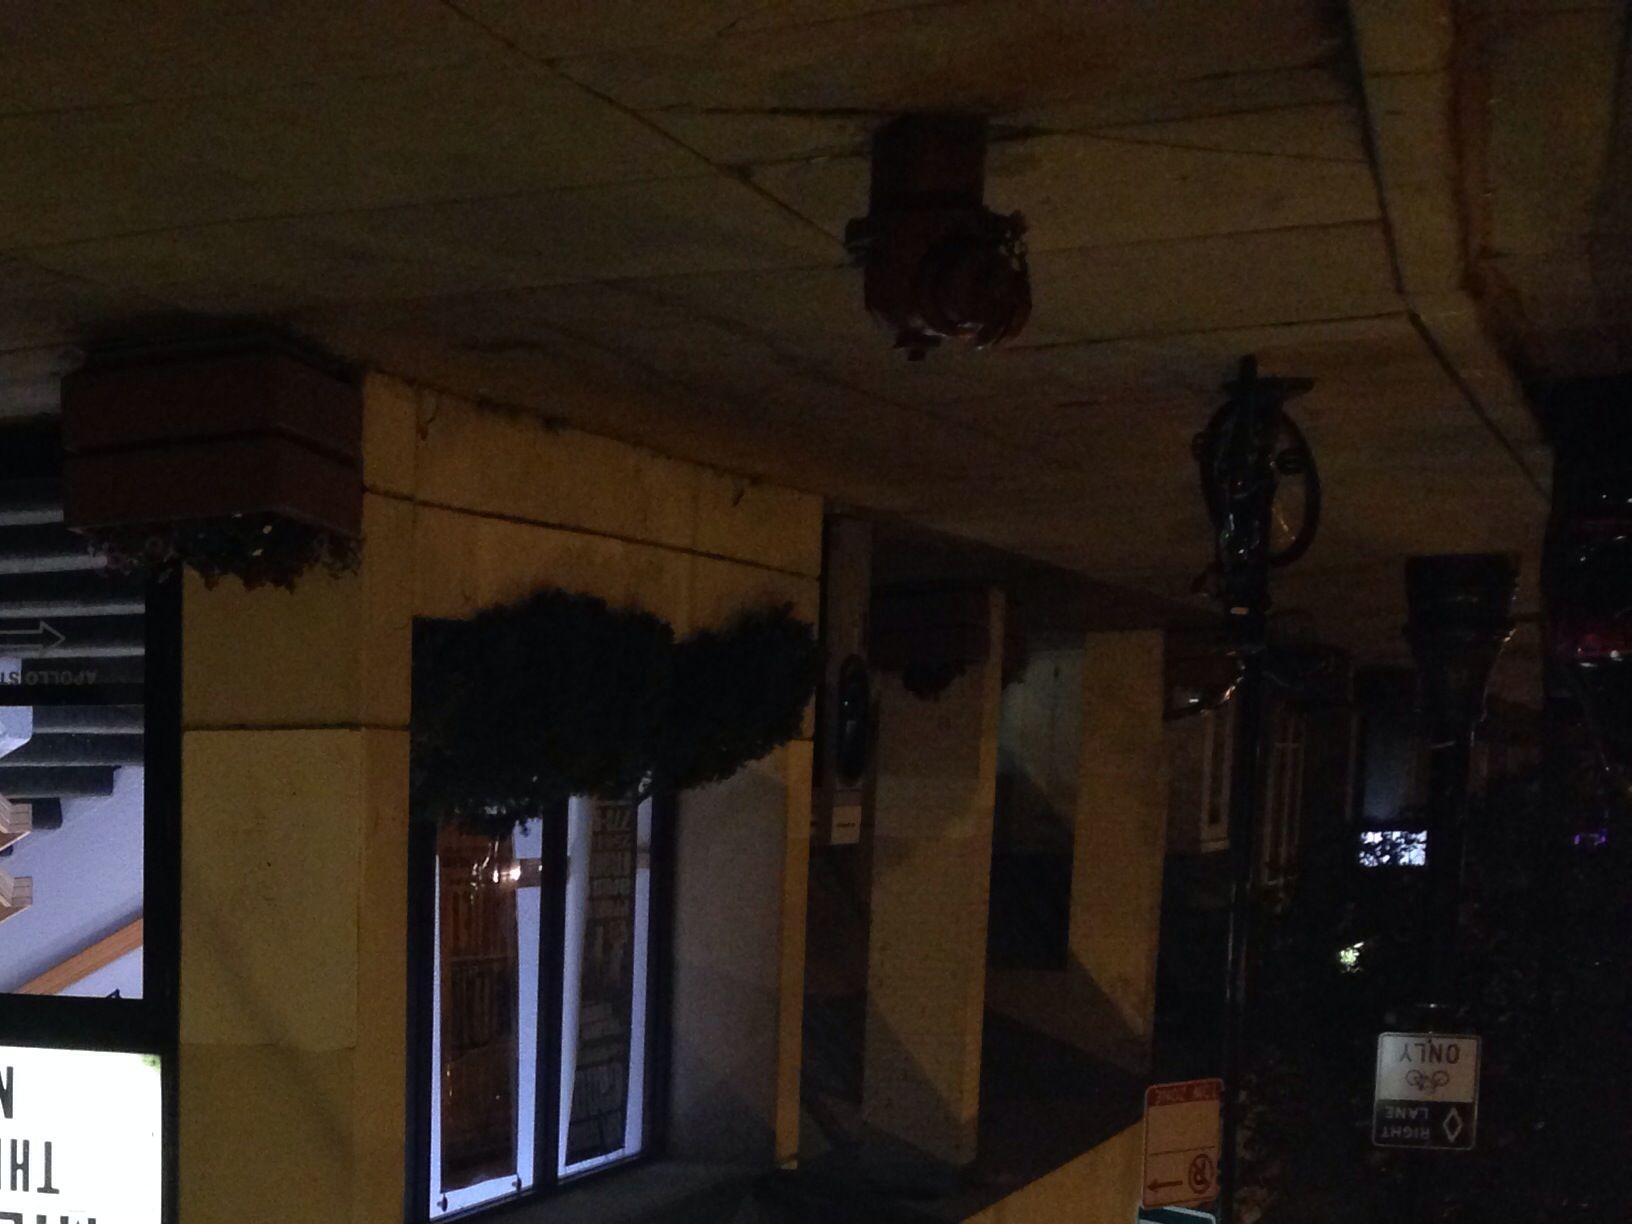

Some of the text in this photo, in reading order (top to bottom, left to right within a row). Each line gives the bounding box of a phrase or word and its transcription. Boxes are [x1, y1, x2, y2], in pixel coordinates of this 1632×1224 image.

[25, 670, 97, 686] APOLLO
[1399, 1042, 1460, 1065] ONLY
[1384, 1106, 1429, 1120] LANE
[1380, 1125, 1430, 1140] RIGHT
